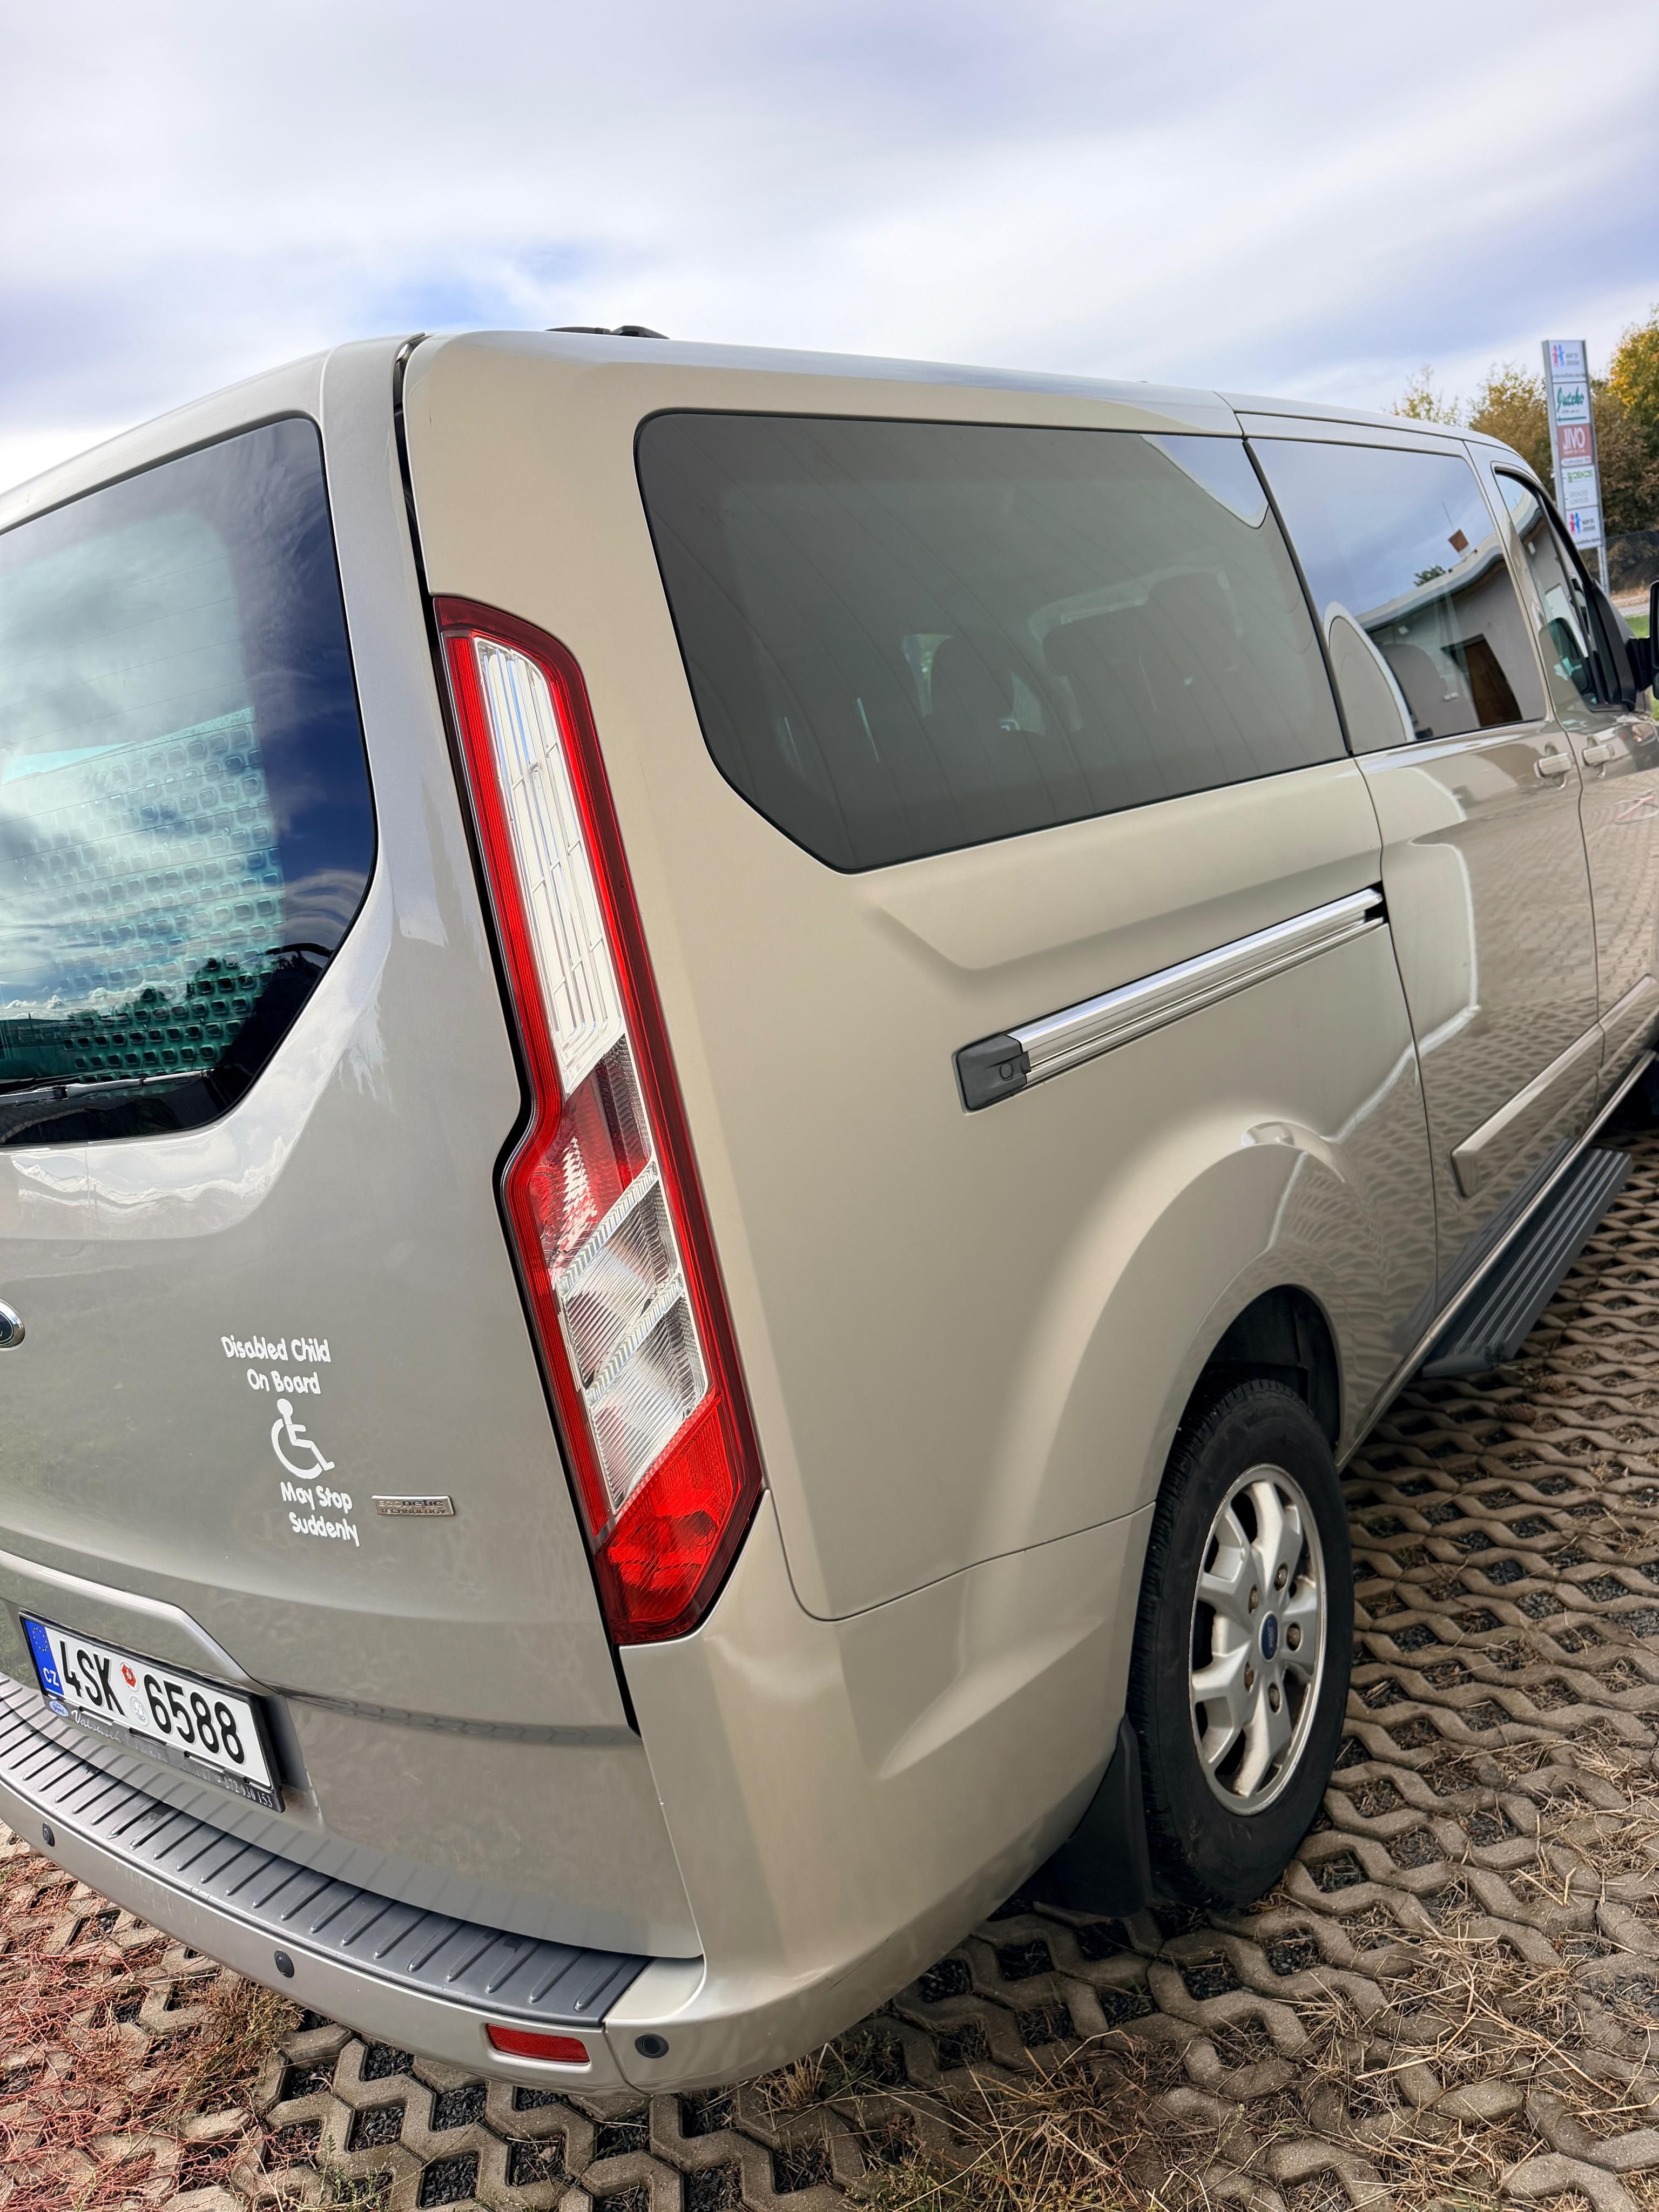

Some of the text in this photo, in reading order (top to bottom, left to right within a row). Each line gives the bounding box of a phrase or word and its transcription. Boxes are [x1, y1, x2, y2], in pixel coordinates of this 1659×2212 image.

[1562, 427, 1586, 450] JIVO
[220, 1334, 332, 1363] Disabled Child
[247, 1368, 321, 1394] On Board
[280, 1481, 353, 1514] May Stop
[288, 1512, 360, 1547] Suddenly
[43, 1667, 60, 1687] CZ
[59, 1640, 245, 1765] 4SK 6588
[240, 1784, 256, 1801] 930
[258, 1791, 273, 1808] 153
